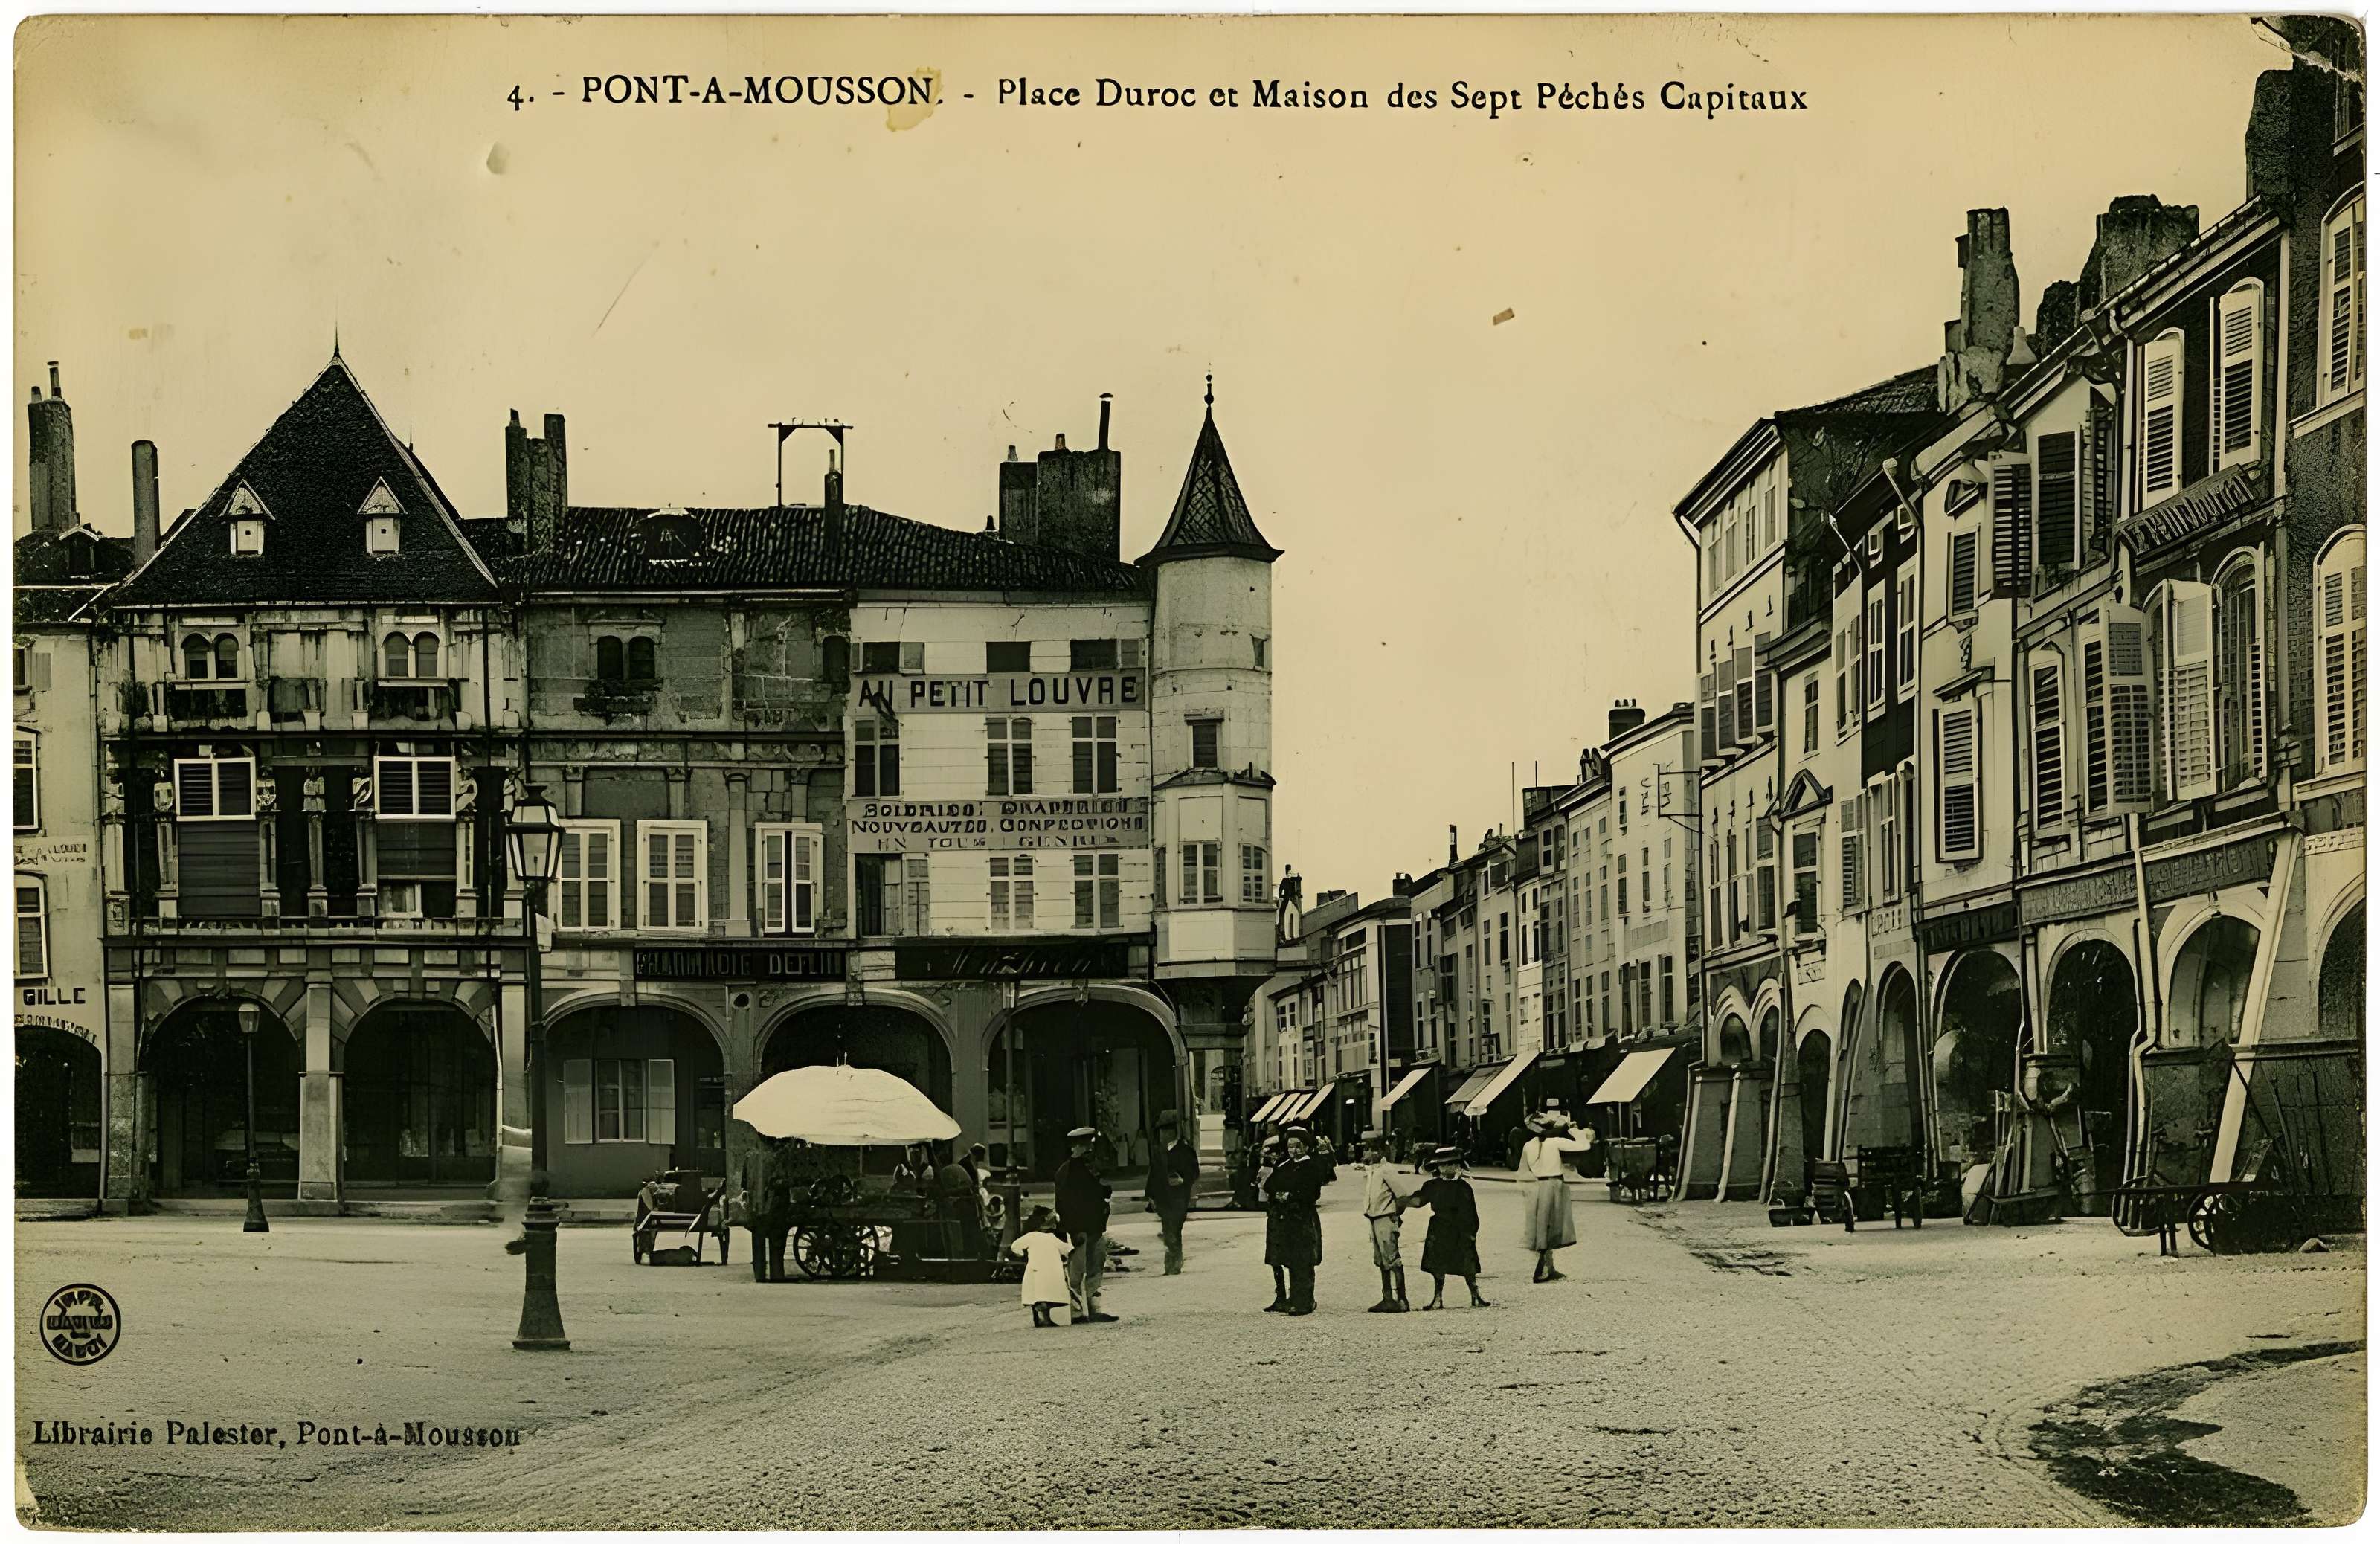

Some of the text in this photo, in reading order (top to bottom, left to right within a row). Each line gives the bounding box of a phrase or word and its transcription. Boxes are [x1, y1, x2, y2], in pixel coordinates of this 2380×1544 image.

[859, 676, 1137, 707] AU PETIT LOUVRE
